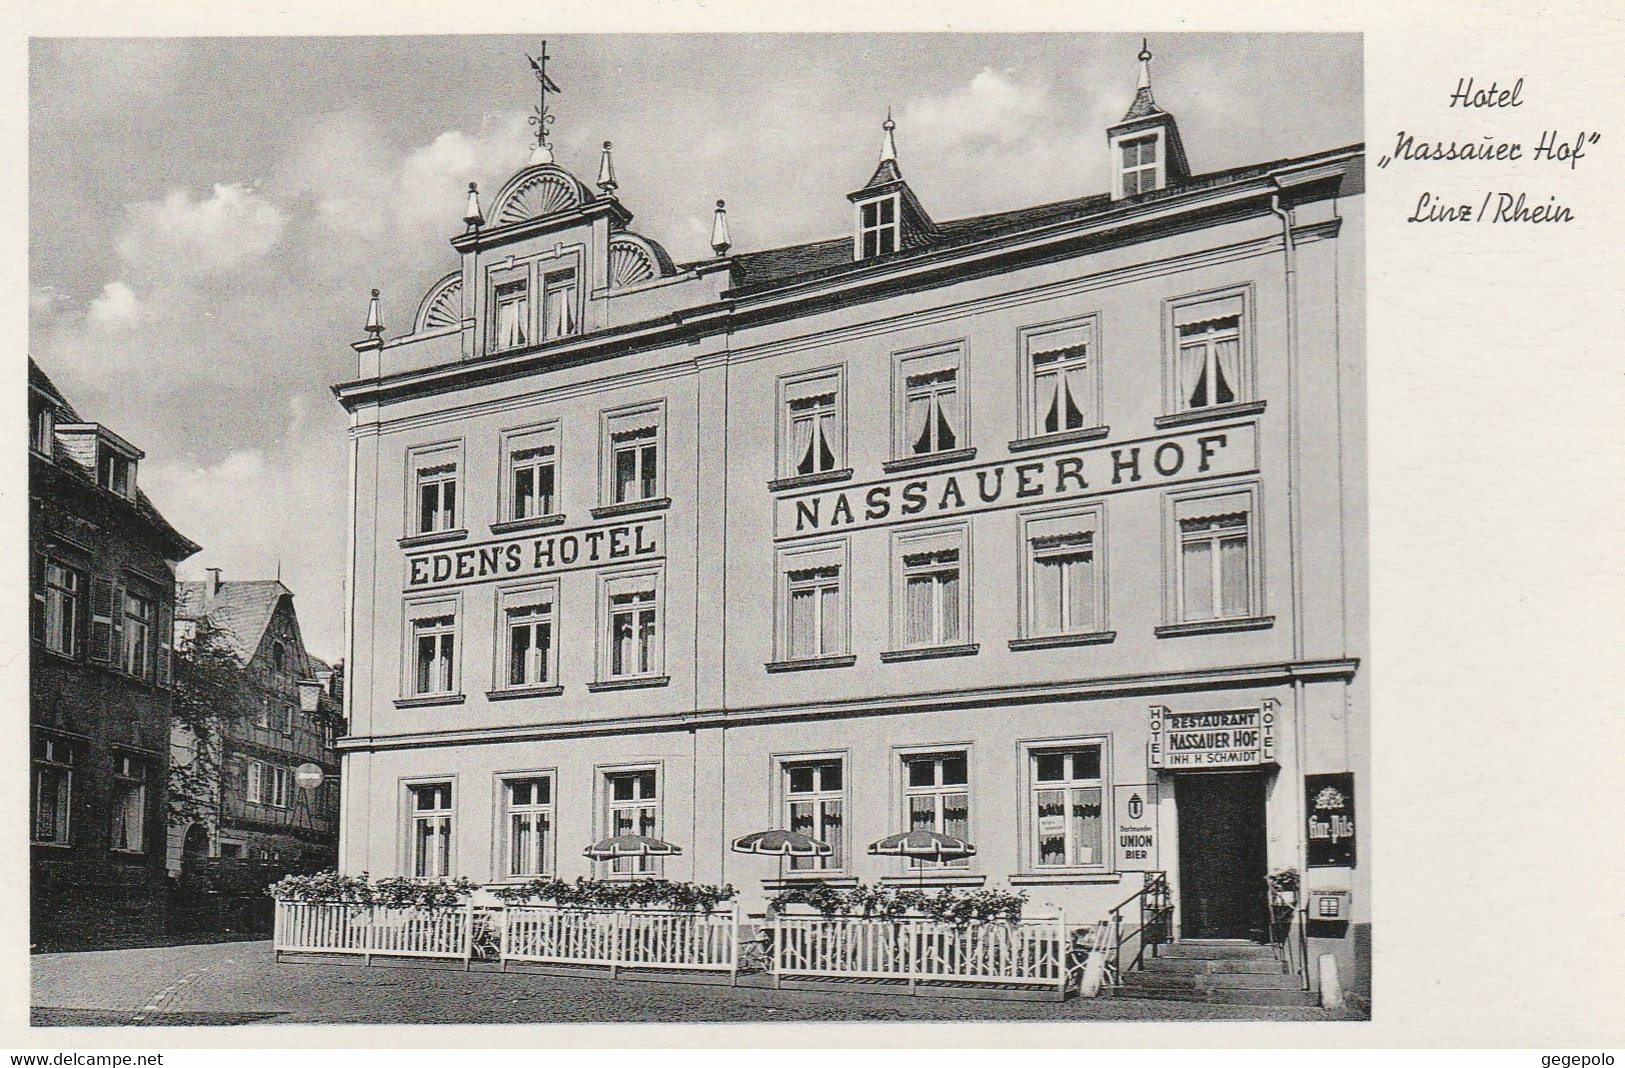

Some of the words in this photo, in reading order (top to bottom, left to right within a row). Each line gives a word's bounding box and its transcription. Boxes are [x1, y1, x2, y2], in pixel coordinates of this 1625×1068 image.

[1450, 77, 1523, 107] Hotel
[795, 456, 1089, 531] NASSAUER
[1110, 434, 1228, 484] HOF
[409, 543, 522, 586] EDEN'S
[533, 525, 656, 569] HOTEL
[1171, 714, 1255, 729] RESTAURANT
[1263, 702, 1274, 760] HOTEL
[1150, 709, 1161, 765] HOTEL
[1169, 732, 1230, 751] NASSAUER
[1233, 731, 1258, 748] HOF
[1207, 751, 1257, 764] SCHMIDT
[1120, 835, 1153, 847] UNION
[1125, 850, 1148, 860] BIER
